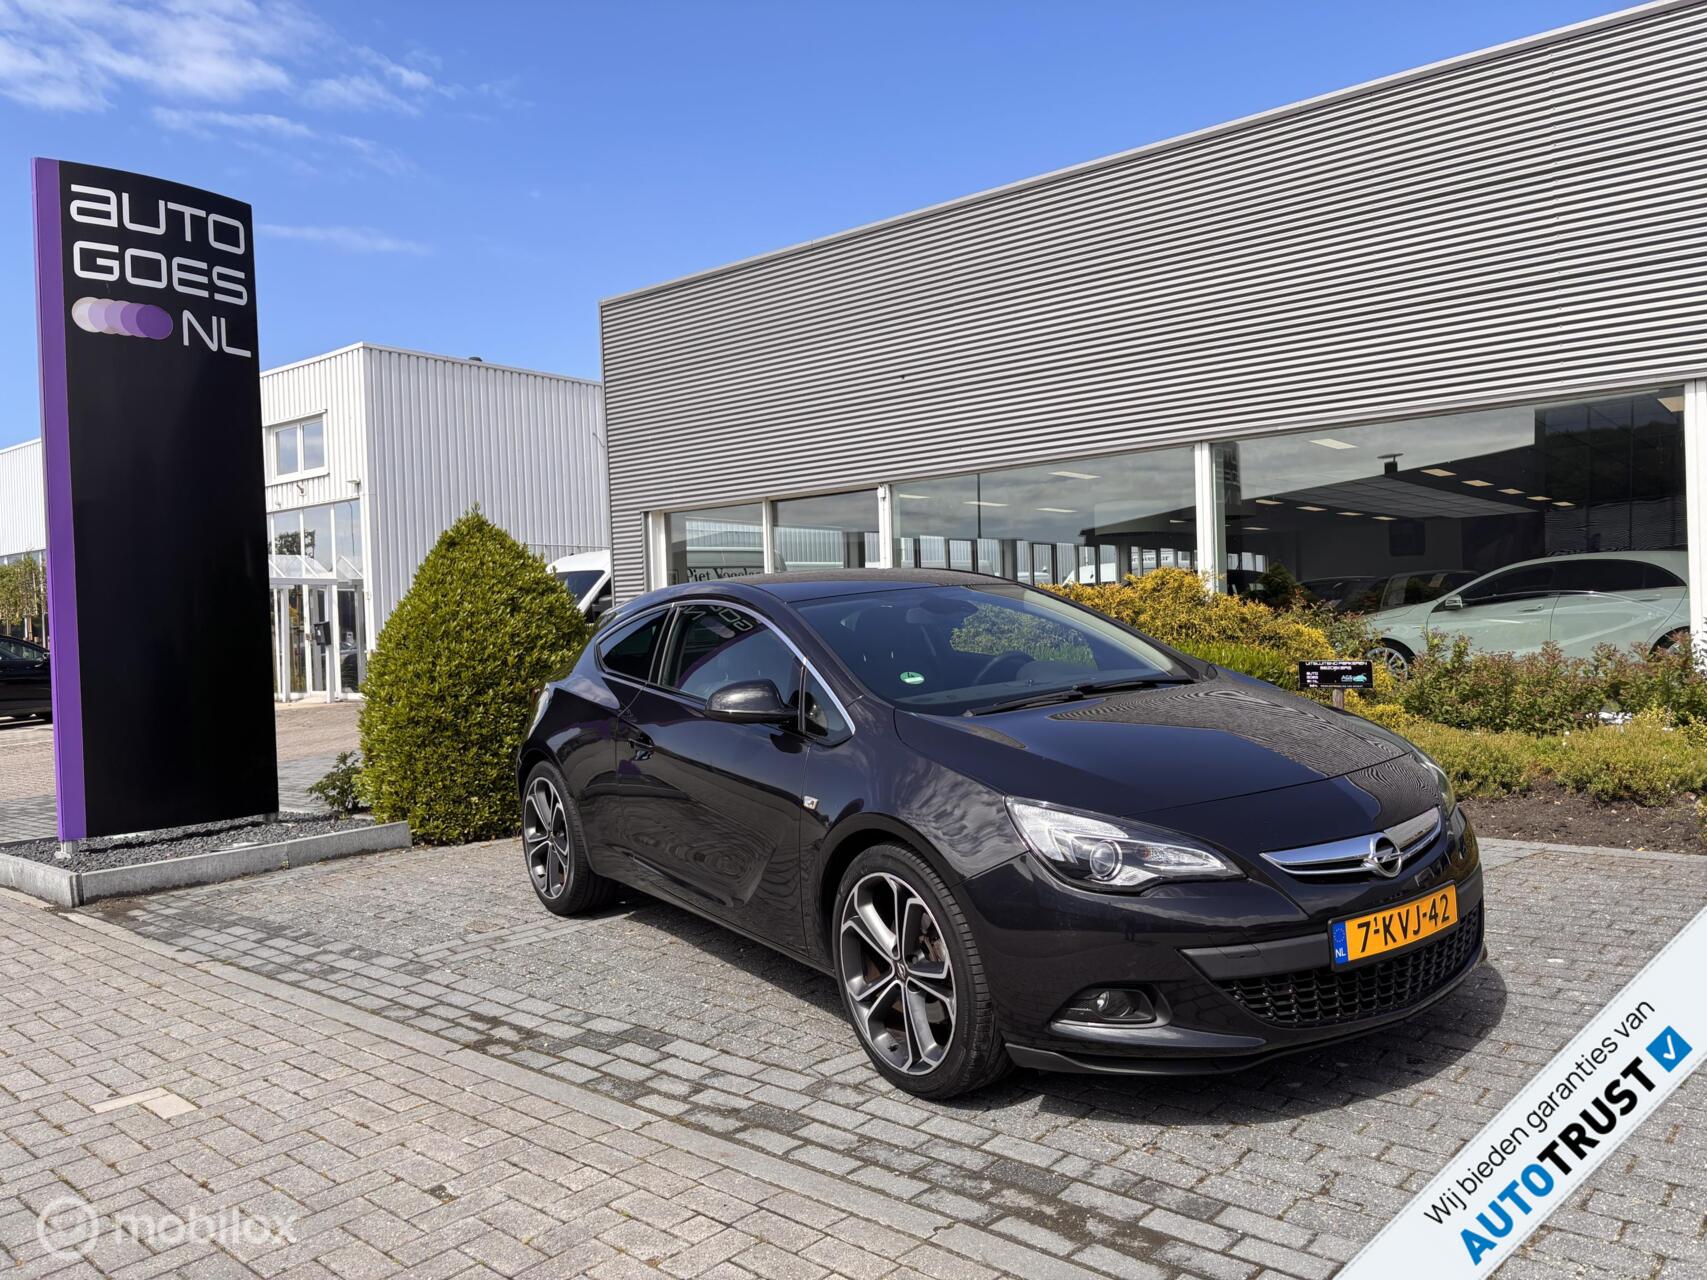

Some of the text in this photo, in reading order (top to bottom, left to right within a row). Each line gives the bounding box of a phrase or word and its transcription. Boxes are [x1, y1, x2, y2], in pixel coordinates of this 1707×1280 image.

[73, 240, 248, 306] GOES
[182, 309, 252, 358] NL
[1335, 947, 1347, 959] NL
